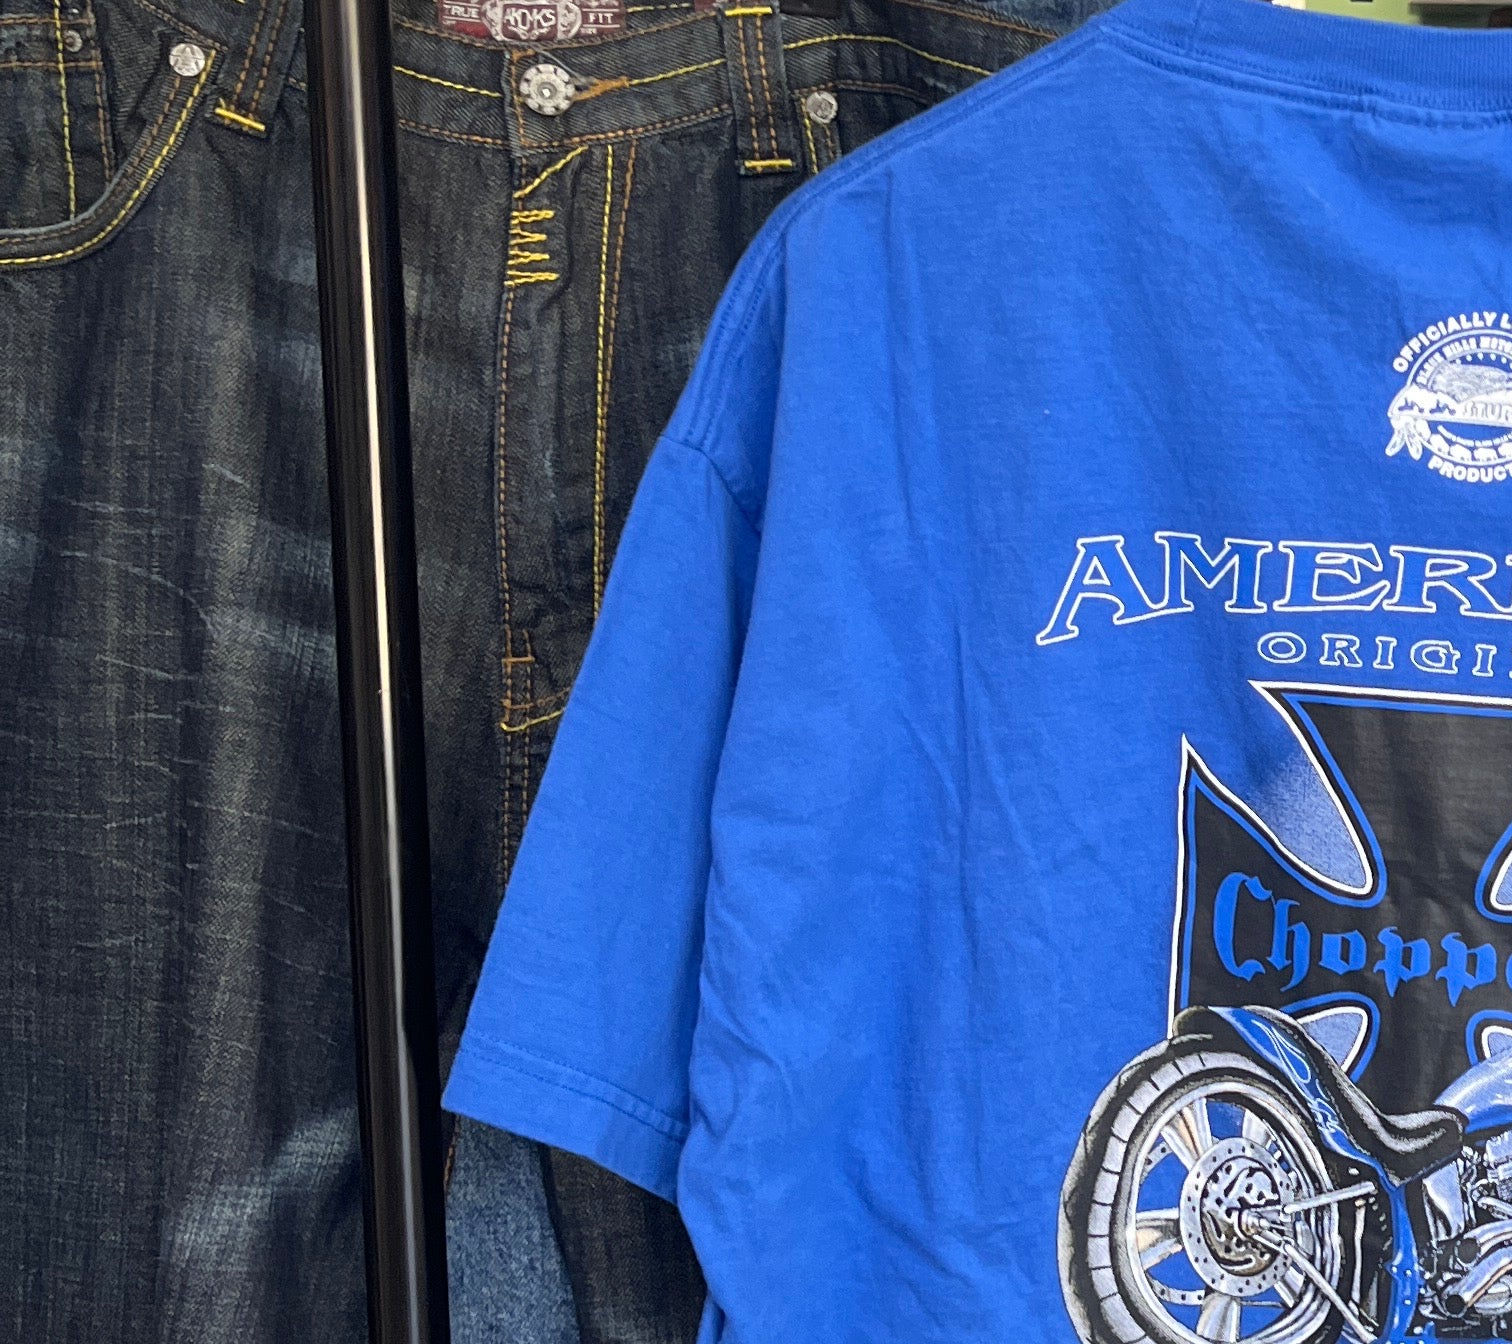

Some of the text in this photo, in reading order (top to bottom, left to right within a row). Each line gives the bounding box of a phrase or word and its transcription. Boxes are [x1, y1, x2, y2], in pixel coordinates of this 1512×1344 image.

[443, 4, 614, 25] TRUE FIT
[1393, 311, 1497, 373] OFFICIALLY
